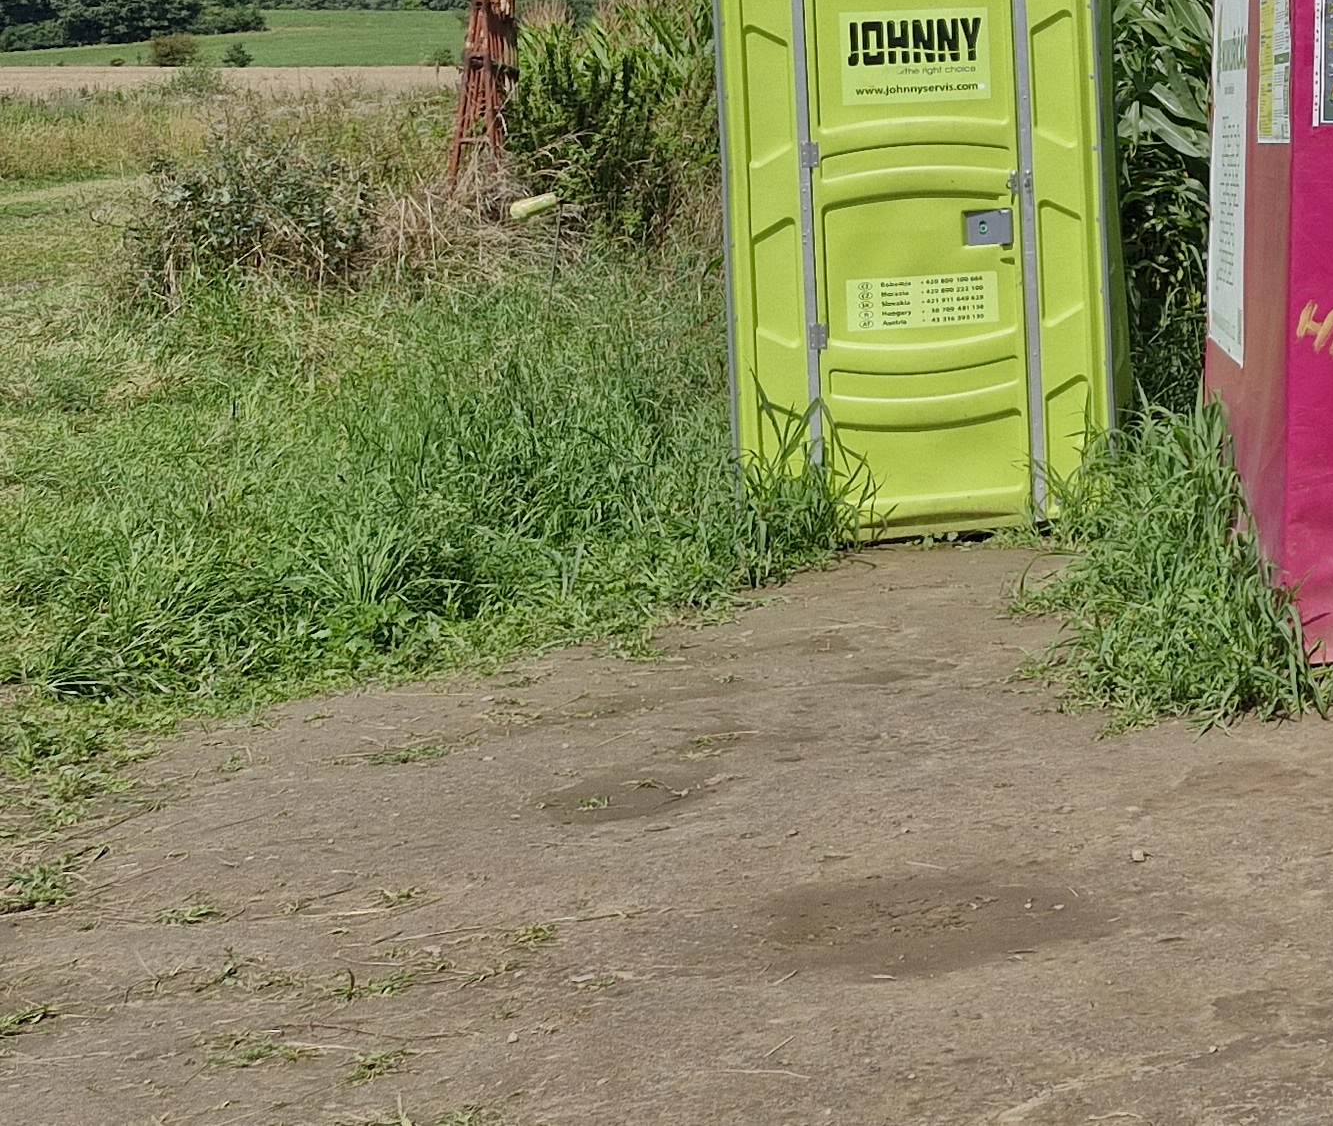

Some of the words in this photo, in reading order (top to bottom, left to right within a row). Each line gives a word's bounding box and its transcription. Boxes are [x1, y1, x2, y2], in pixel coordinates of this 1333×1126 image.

[847, 17, 982, 67] JOHNNY
[922, 66, 942, 76] right
[944, 64, 976, 74] choice
[855, 81, 979, 96] www.johnnyservis.com
